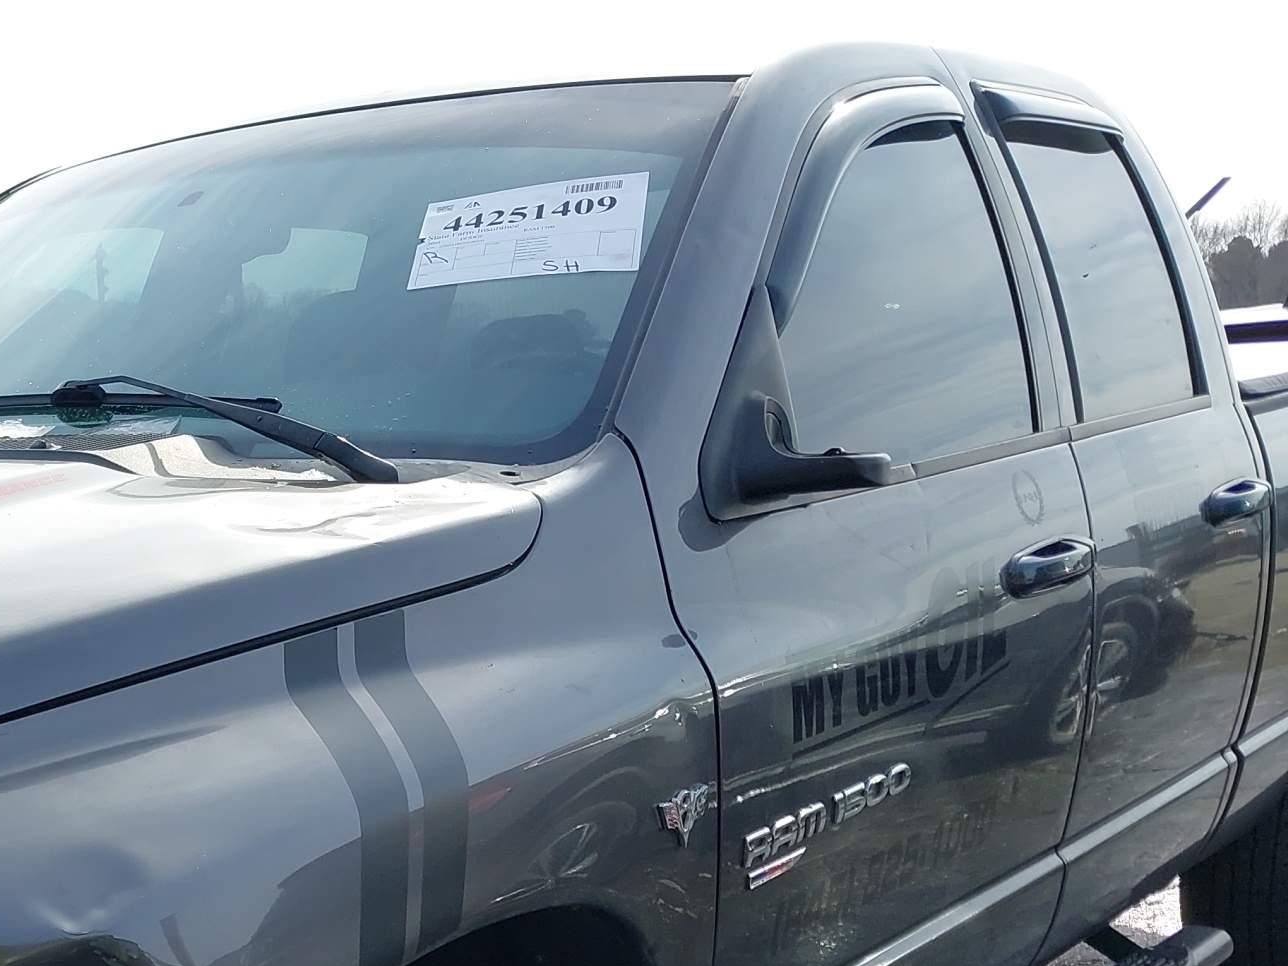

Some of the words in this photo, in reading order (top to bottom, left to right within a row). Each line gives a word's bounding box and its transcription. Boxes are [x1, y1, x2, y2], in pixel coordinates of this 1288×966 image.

[443, 195, 618, 232] 44251409
[792, 661, 844, 744] MY
[855, 632, 918, 717] GUY
[742, 801, 827, 868] RAM
[832, 762, 912, 825] 1500
